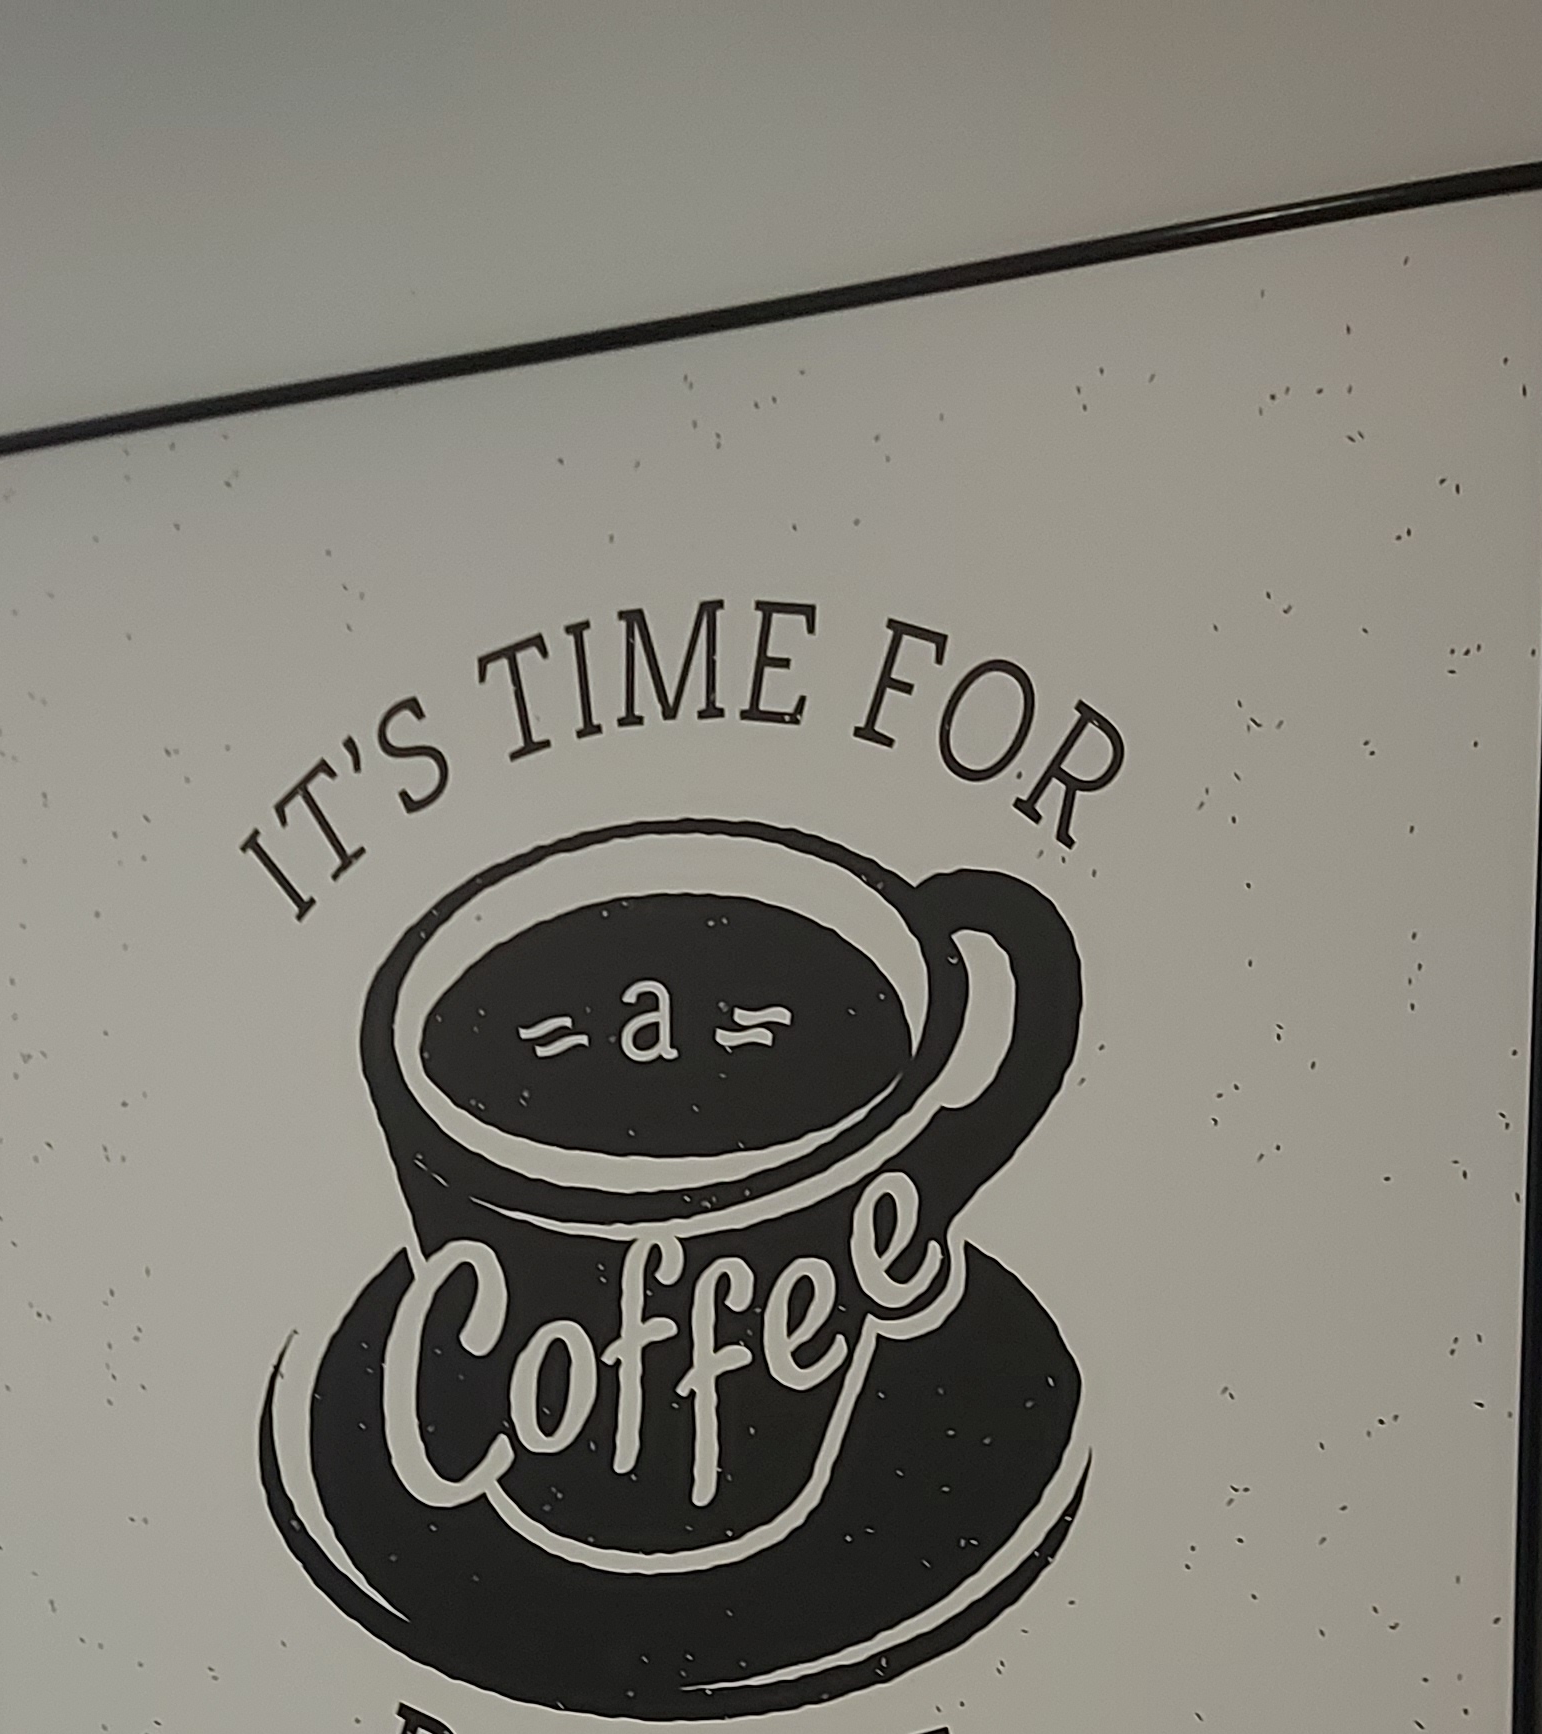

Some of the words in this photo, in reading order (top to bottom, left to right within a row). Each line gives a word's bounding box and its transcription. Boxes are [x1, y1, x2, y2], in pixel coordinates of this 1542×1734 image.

[240, 695, 451, 922] IT'S
[477, 599, 817, 762] TIME
[853, 618, 1126, 850] FOR
[619, 980, 679, 1062] a
[383, 1171, 946, 1508] Coffee
